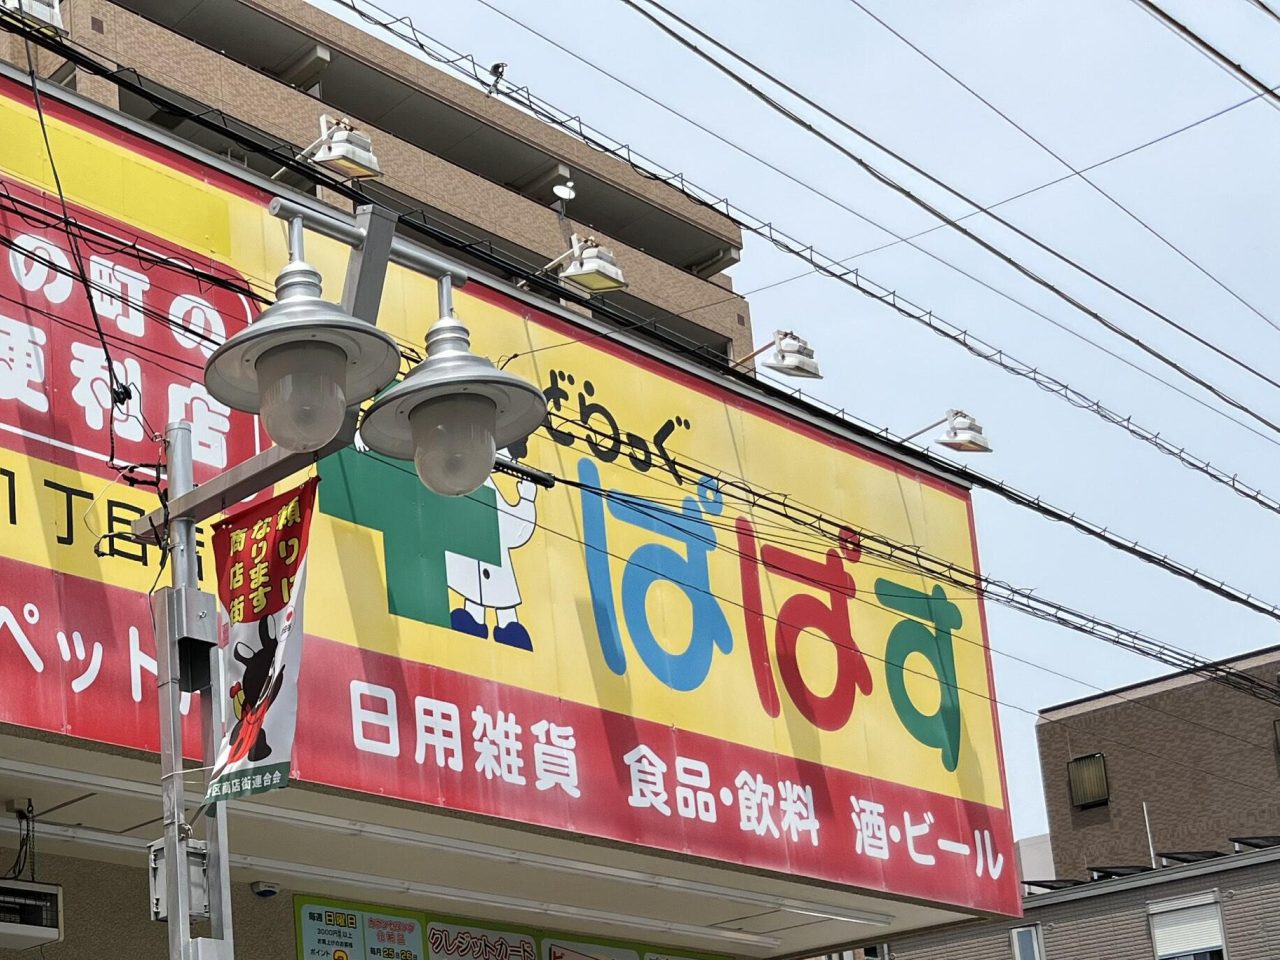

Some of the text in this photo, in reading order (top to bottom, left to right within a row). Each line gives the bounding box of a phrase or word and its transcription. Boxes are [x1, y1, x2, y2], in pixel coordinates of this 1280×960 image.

[228, 526, 248, 625] 商店街
[248, 518, 272, 614] なります
[577, 456, 963, 772] ぱぱす
[349, 679, 581, 799] 日用雑貨
[325, 910, 357, 929] 日曜日
